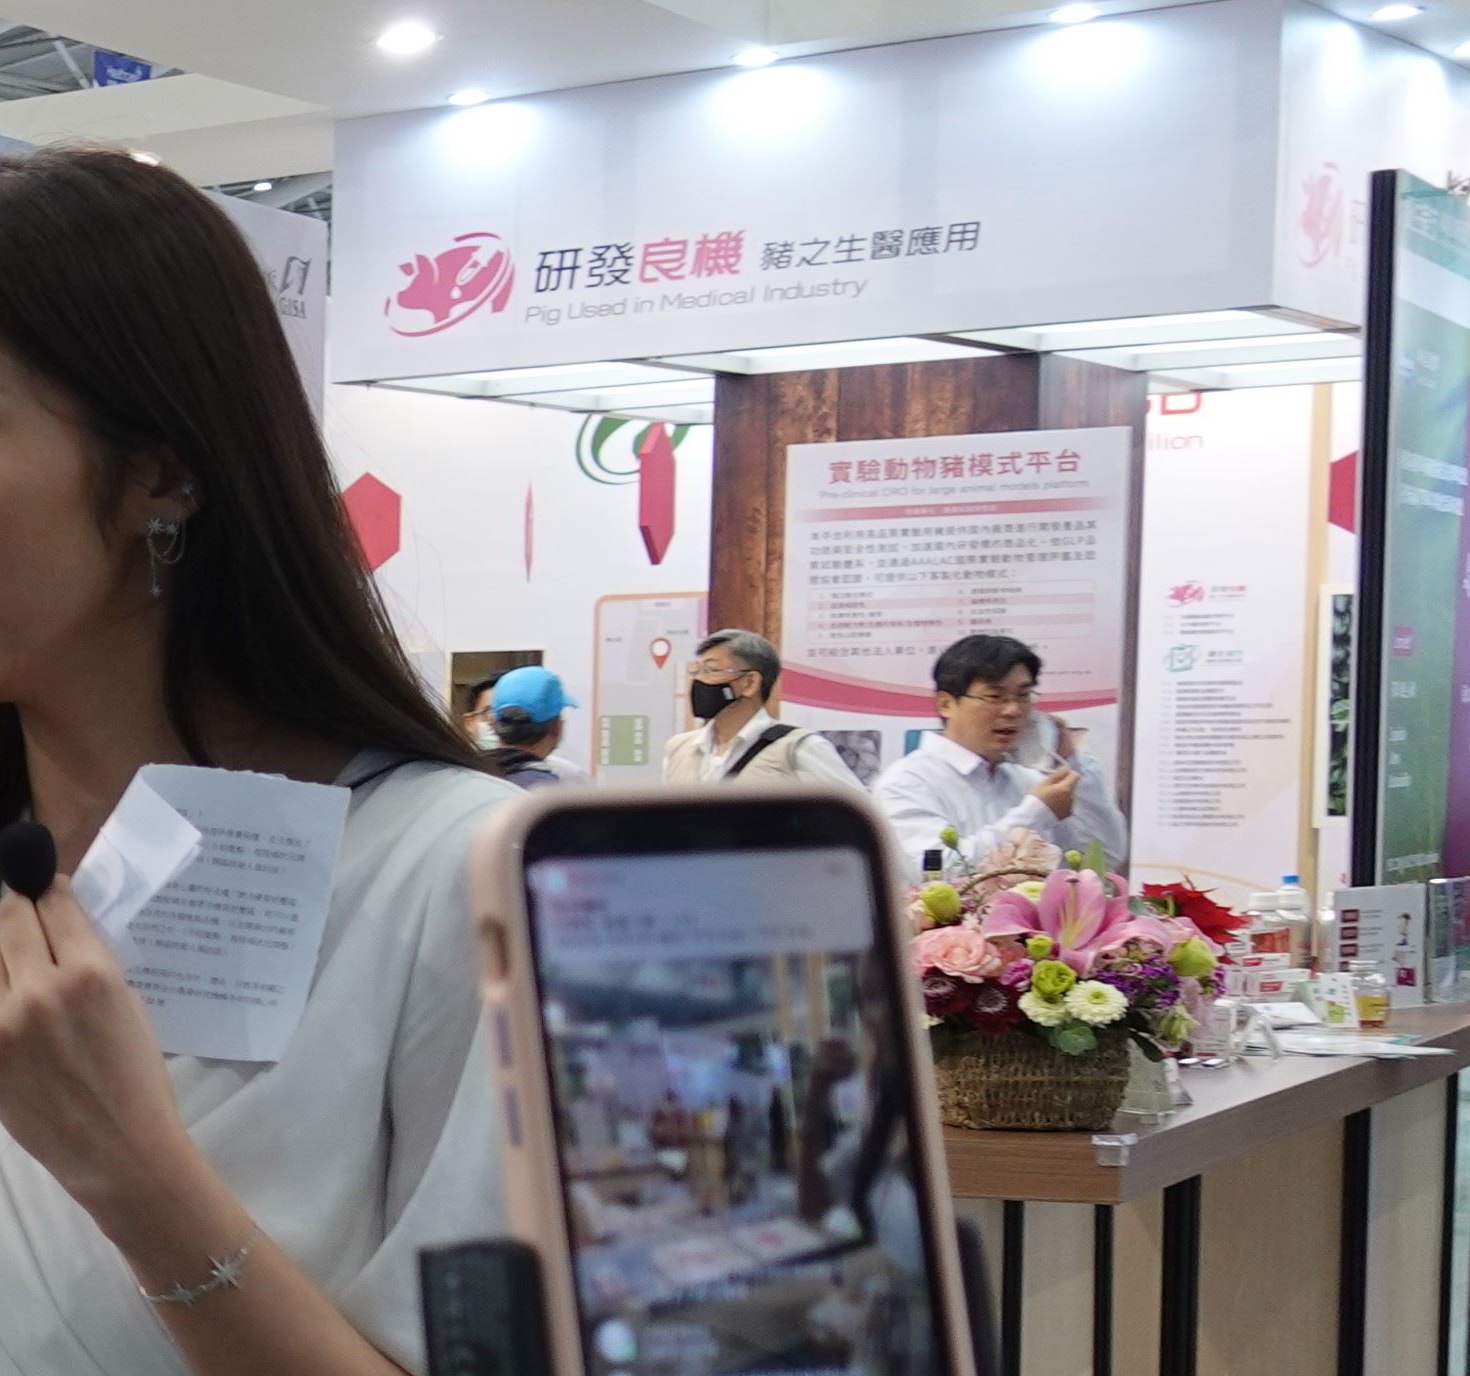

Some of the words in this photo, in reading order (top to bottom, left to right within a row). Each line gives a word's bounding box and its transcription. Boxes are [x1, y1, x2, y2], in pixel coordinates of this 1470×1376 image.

[535, 230, 745, 293] 研發良機
[760, 221, 981, 271] 豬之生醫應用
[525, 306, 561, 326] Pig
[568, 298, 627, 320] Used
[634, 300, 654, 314] in
[660, 287, 755, 312] Medical
[764, 278, 869, 301] Industry
[828, 449, 1081, 485] 實驗動物豬模式平台
